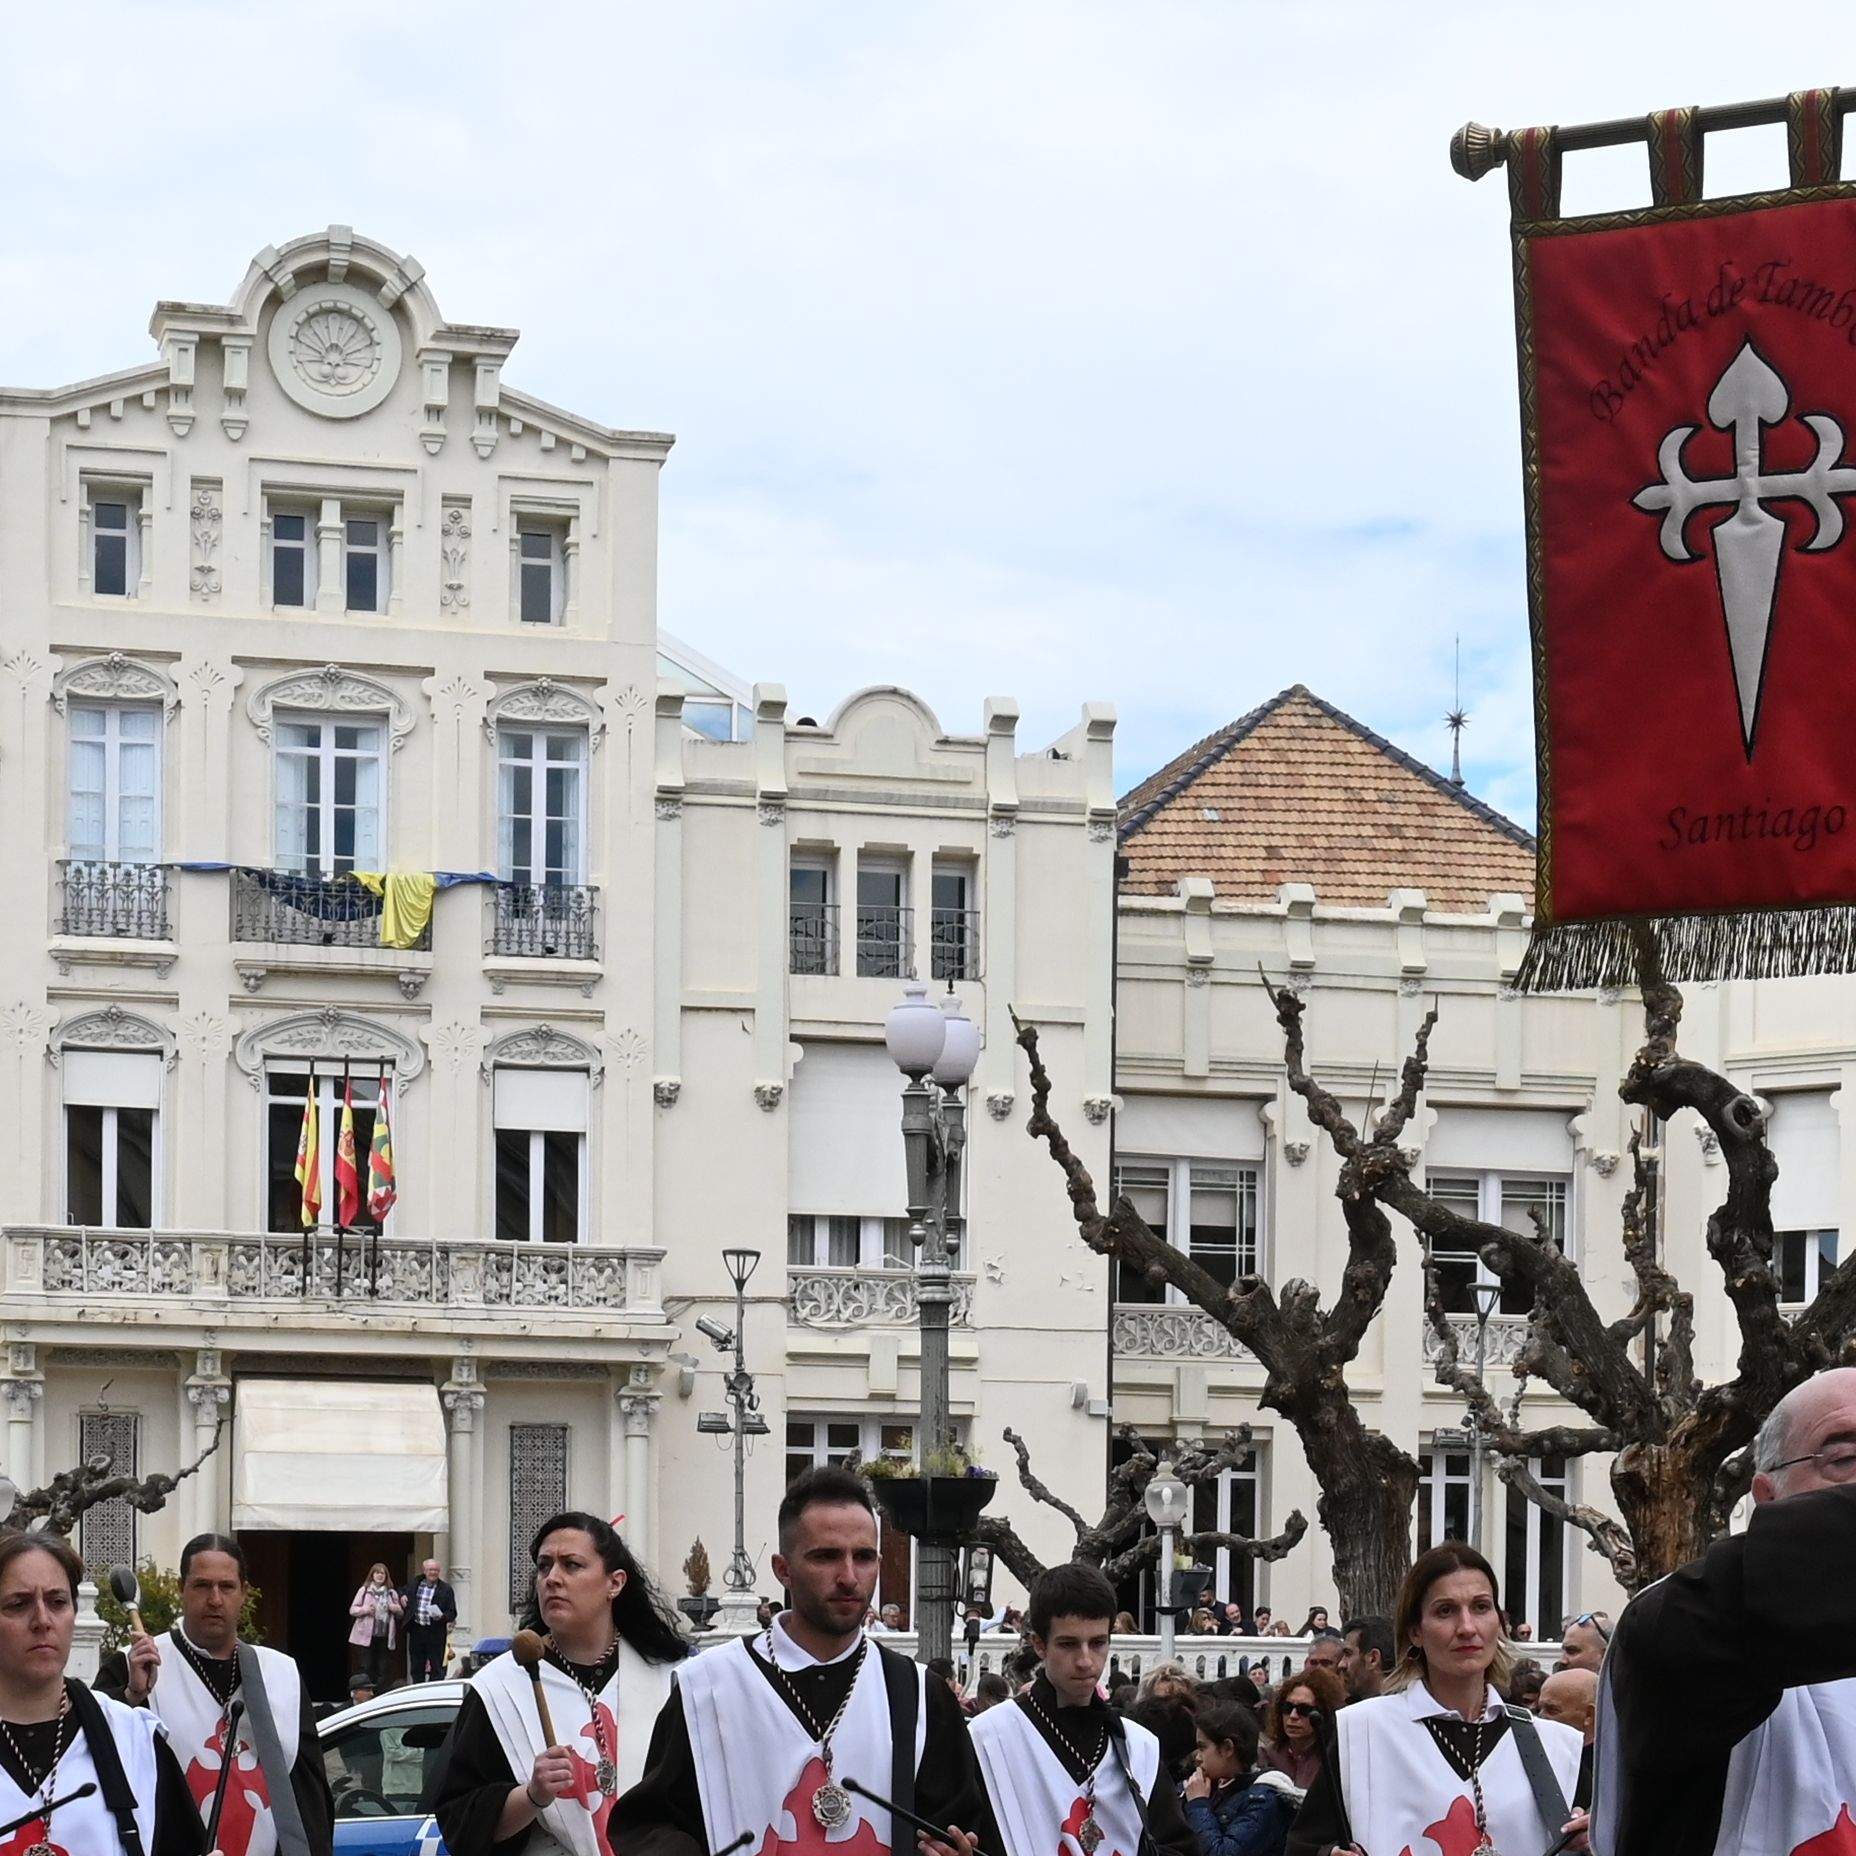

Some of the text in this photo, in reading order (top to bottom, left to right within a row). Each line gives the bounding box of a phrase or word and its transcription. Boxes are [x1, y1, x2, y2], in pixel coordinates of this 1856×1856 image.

[1589, 292, 1701, 423] Banda
[1706, 260, 1746, 318] de
[1658, 796, 1847, 852] Santiago
